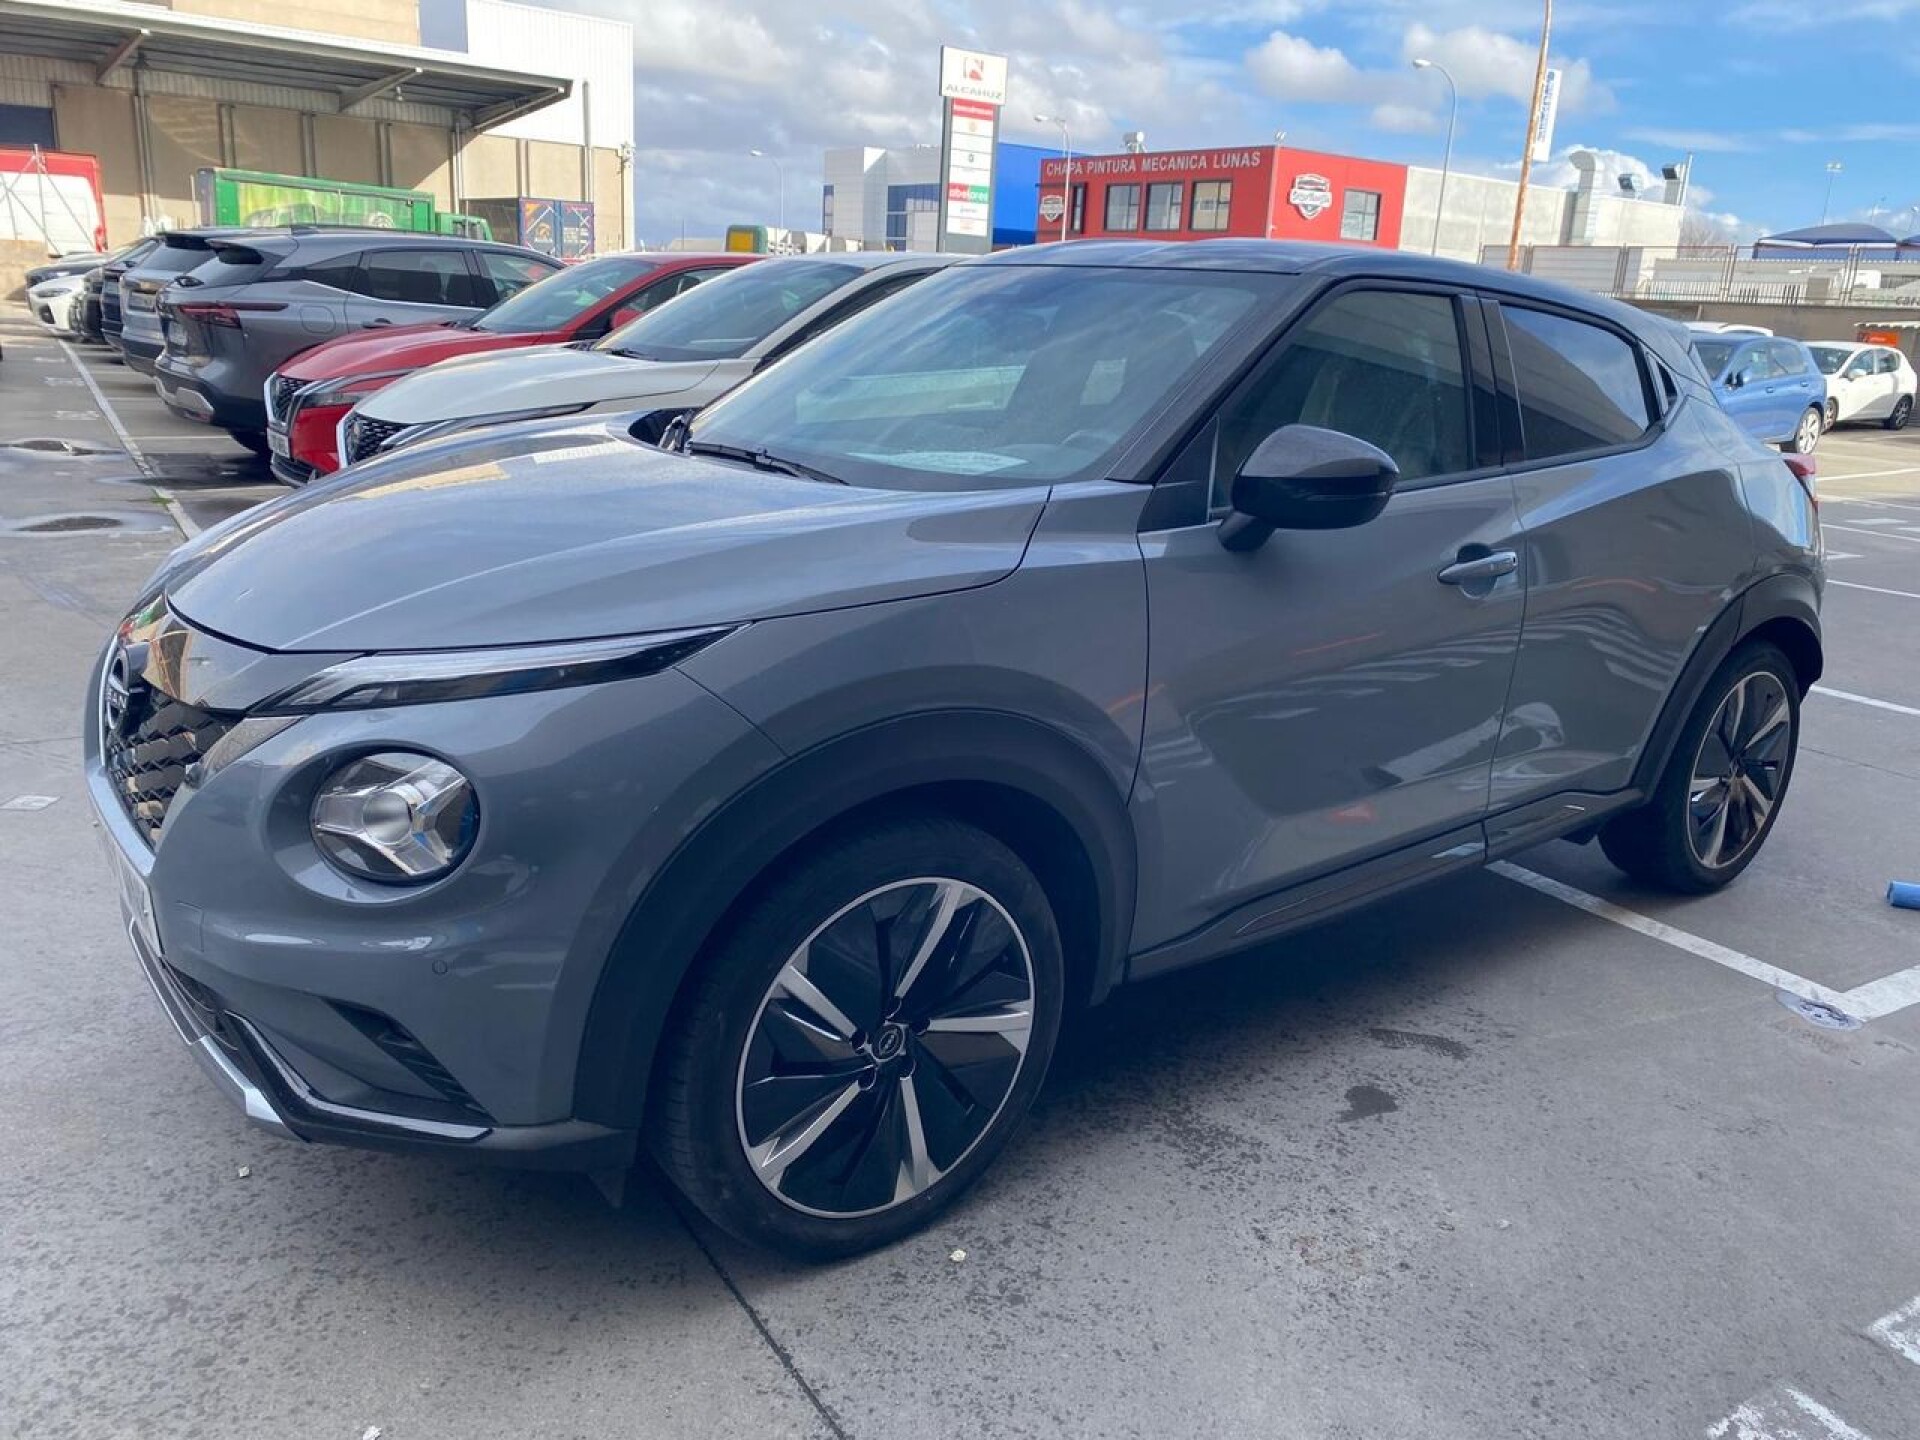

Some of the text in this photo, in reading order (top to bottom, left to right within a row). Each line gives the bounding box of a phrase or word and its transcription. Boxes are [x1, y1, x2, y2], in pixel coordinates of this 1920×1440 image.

[1046, 151, 1261, 175] CHAPA PINTURA MECANICA LUNAS
